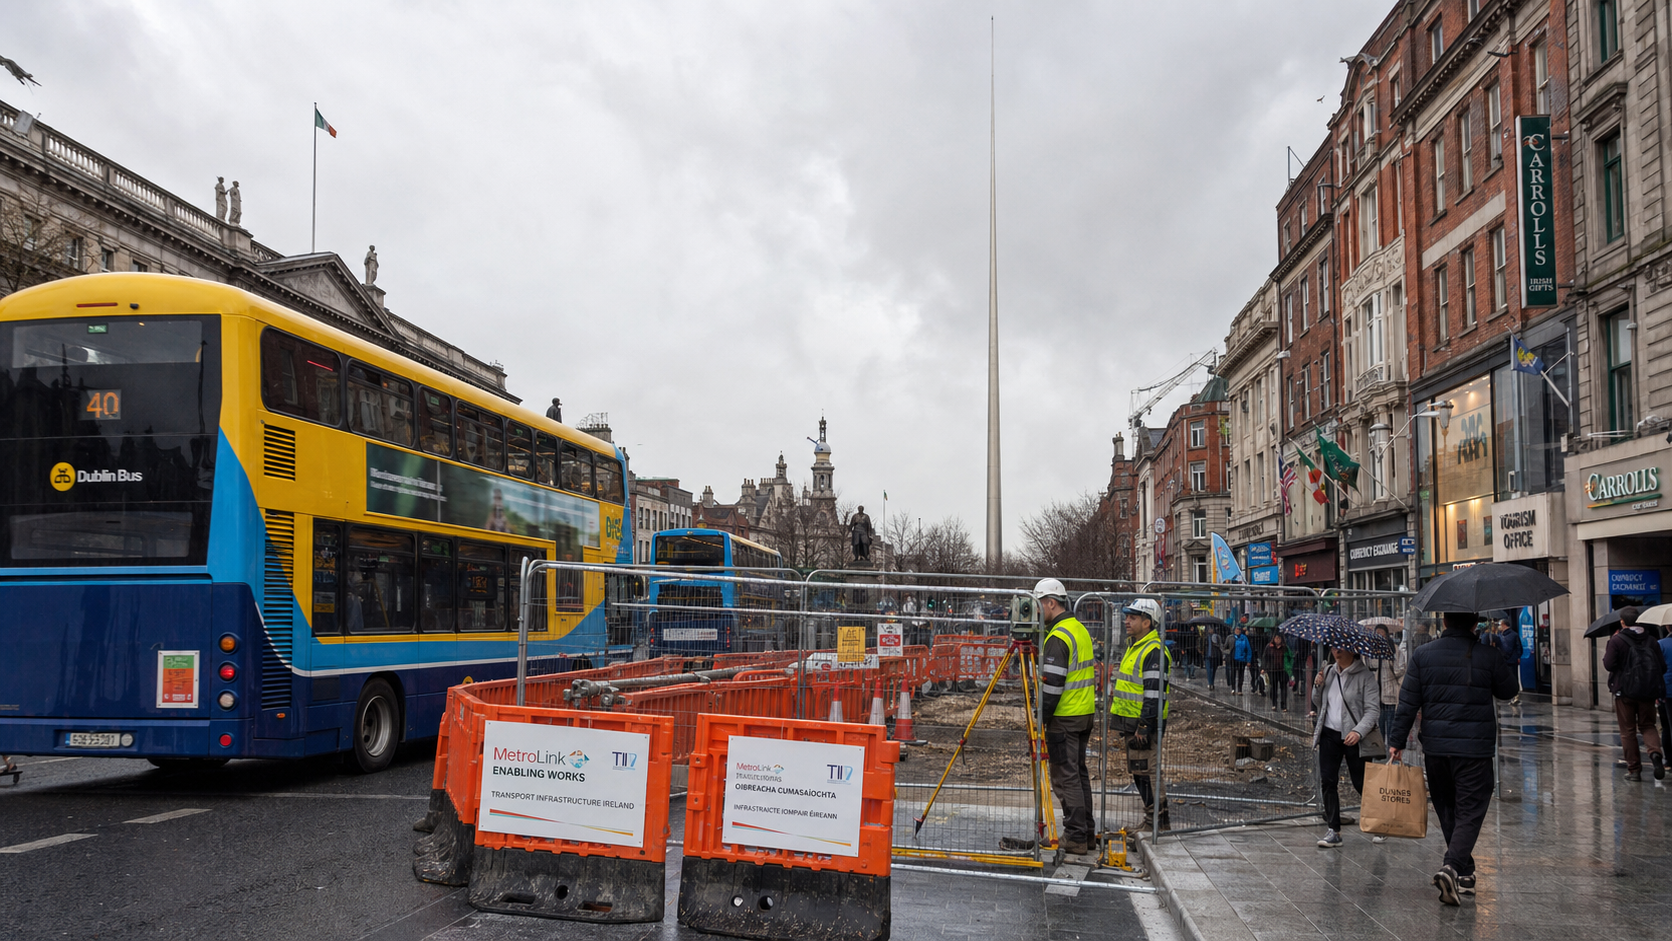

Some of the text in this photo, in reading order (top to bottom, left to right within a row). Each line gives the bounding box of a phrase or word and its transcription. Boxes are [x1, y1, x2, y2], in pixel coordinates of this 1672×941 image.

[1528, 133, 1547, 266] CARROLLS
[1528, 284, 1554, 292] GIFTS
[1530, 277, 1553, 285] IRISH
[86, 391, 119, 419] 40
[77, 469, 143, 483] Dublin Bus
[1586, 466, 1660, 502] CARROLLS
[1499, 509, 1537, 530] TOURISM
[1503, 530, 1534, 550] OFFICE
[493, 747, 566, 765] MetroLink
[493, 766, 586, 782] ENABLING WORKS
[736, 762, 771, 772] MetroLink
[735, 783, 777, 794] OIBREACHA
[1379, 787, 1412, 797] DUNNES
[491, 790, 635, 810] TRANSPORT INFRASTRUCTURE IRELAND
[1380, 795, 1411, 804] STORES
[781, 808, 809, 817] IOMPAIR
[809, 809, 838, 820] ÉIREANN
